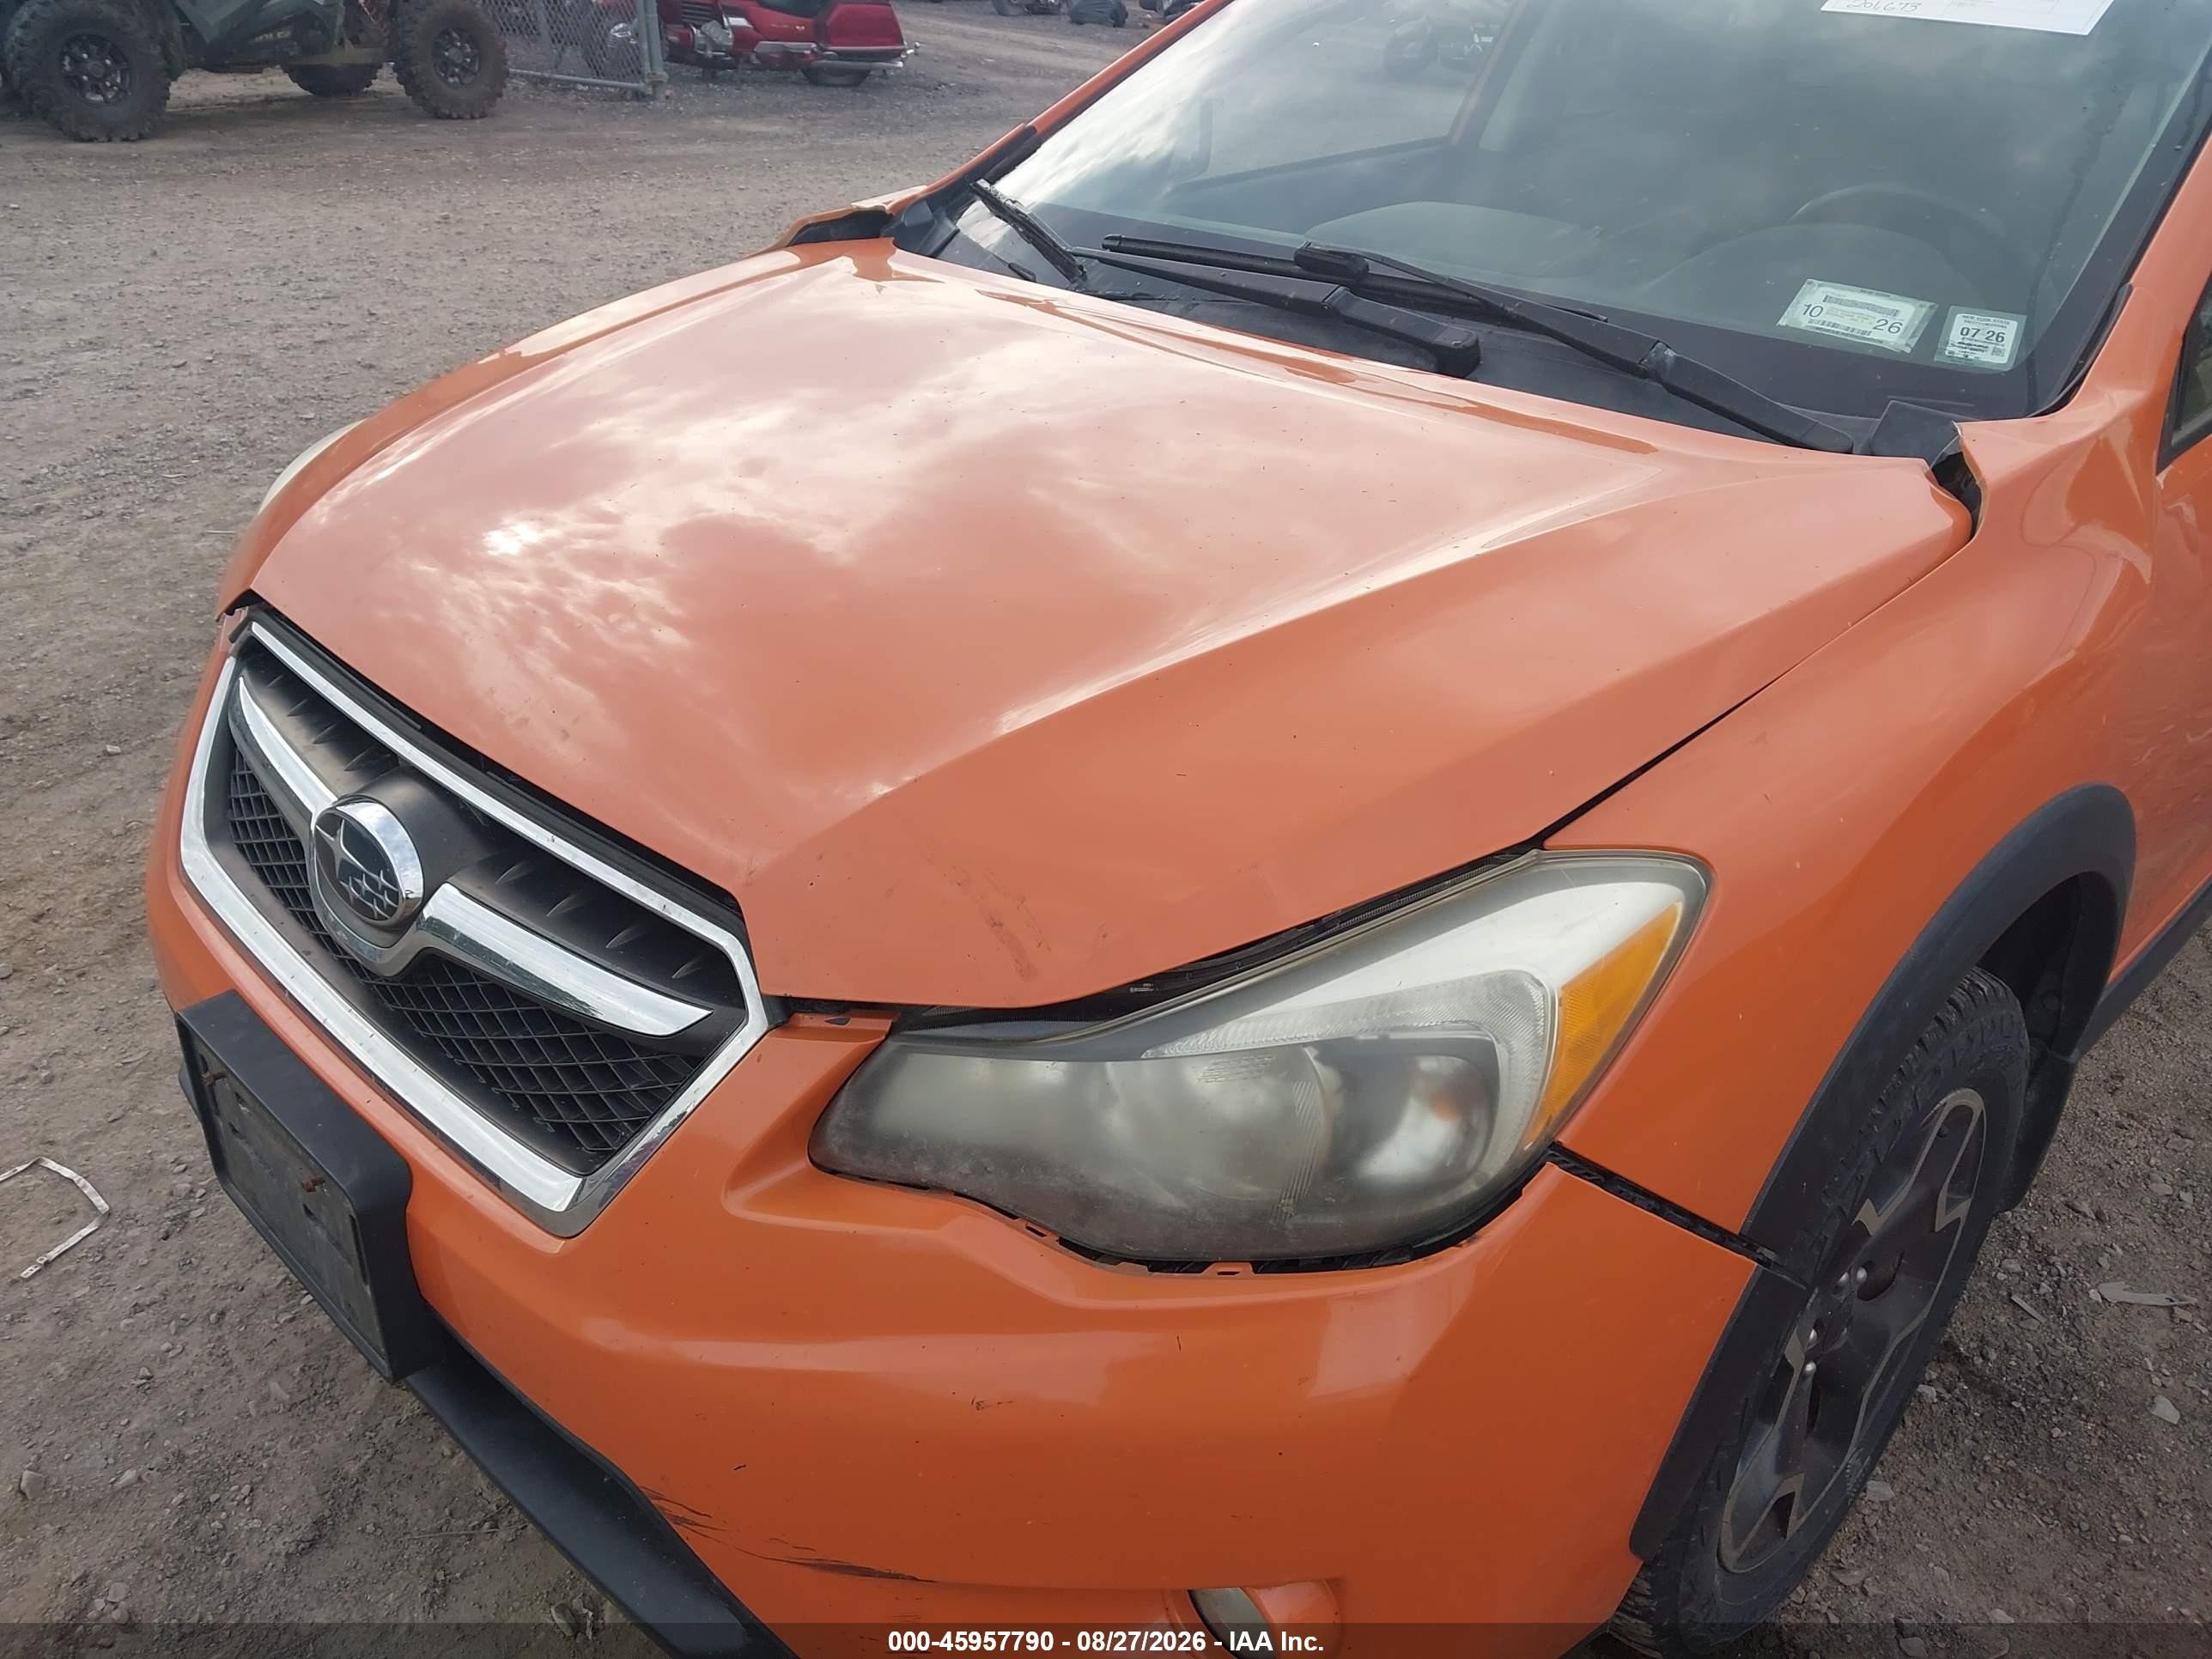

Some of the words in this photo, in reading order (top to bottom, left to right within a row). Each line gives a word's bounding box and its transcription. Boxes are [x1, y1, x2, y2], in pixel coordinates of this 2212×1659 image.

[1802, 303, 1824, 318] 10
[1873, 319, 1904, 334] 26
[1960, 326, 1980, 337] 07
[1985, 330, 2006, 343] 26
